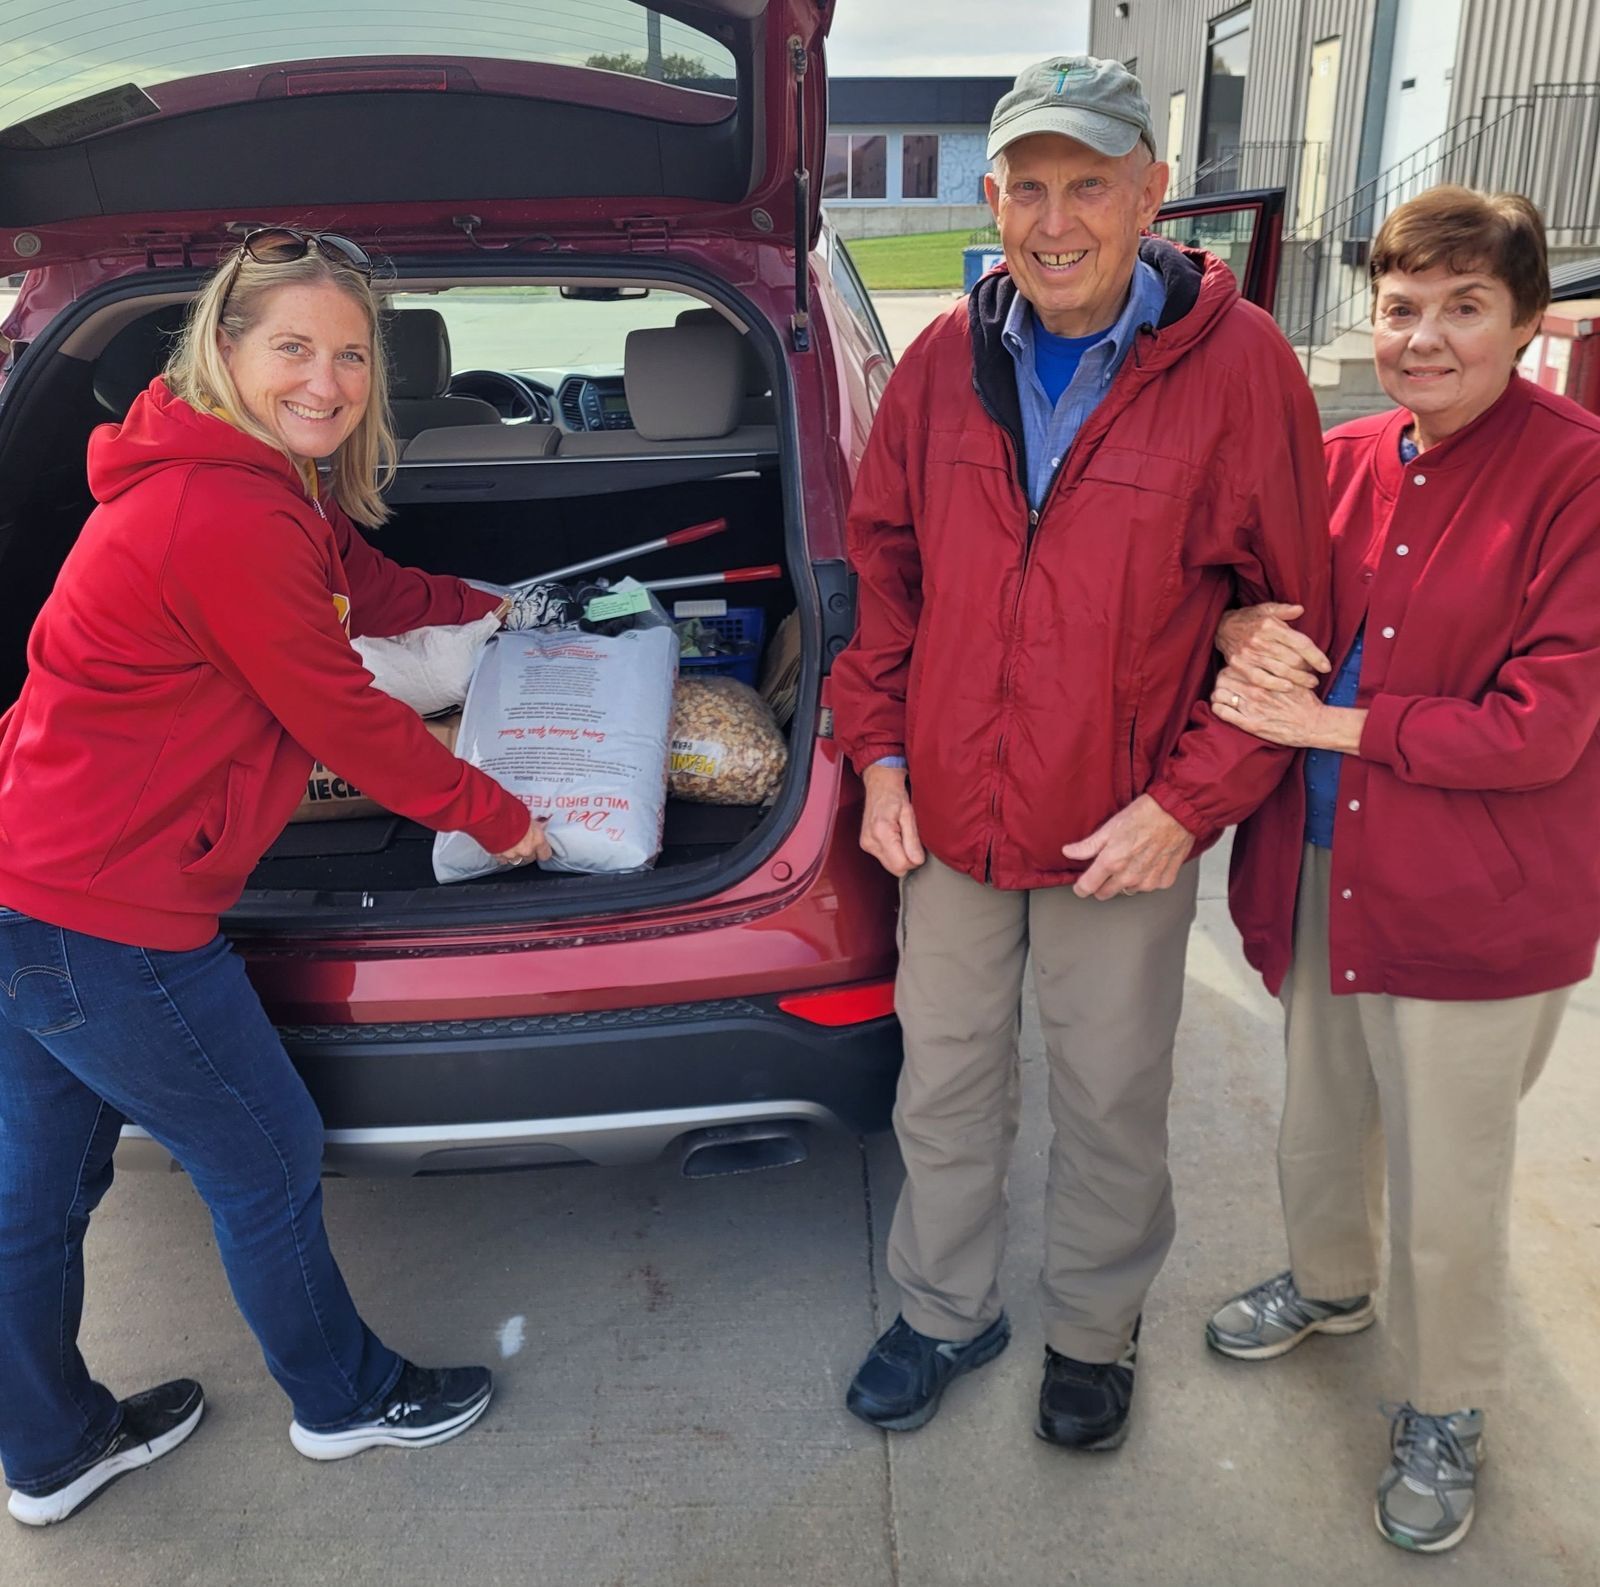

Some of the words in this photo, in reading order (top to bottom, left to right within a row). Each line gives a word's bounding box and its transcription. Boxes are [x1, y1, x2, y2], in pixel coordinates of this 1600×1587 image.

[528, 725, 546, 739] Year
[548, 725, 579, 740] Feeding
[582, 729, 606, 743] Enjoy
[555, 796, 589, 808] BIRD
[593, 796, 629, 810] WILD
[566, 810, 610, 832] Des
[606, 828, 625, 842] The
